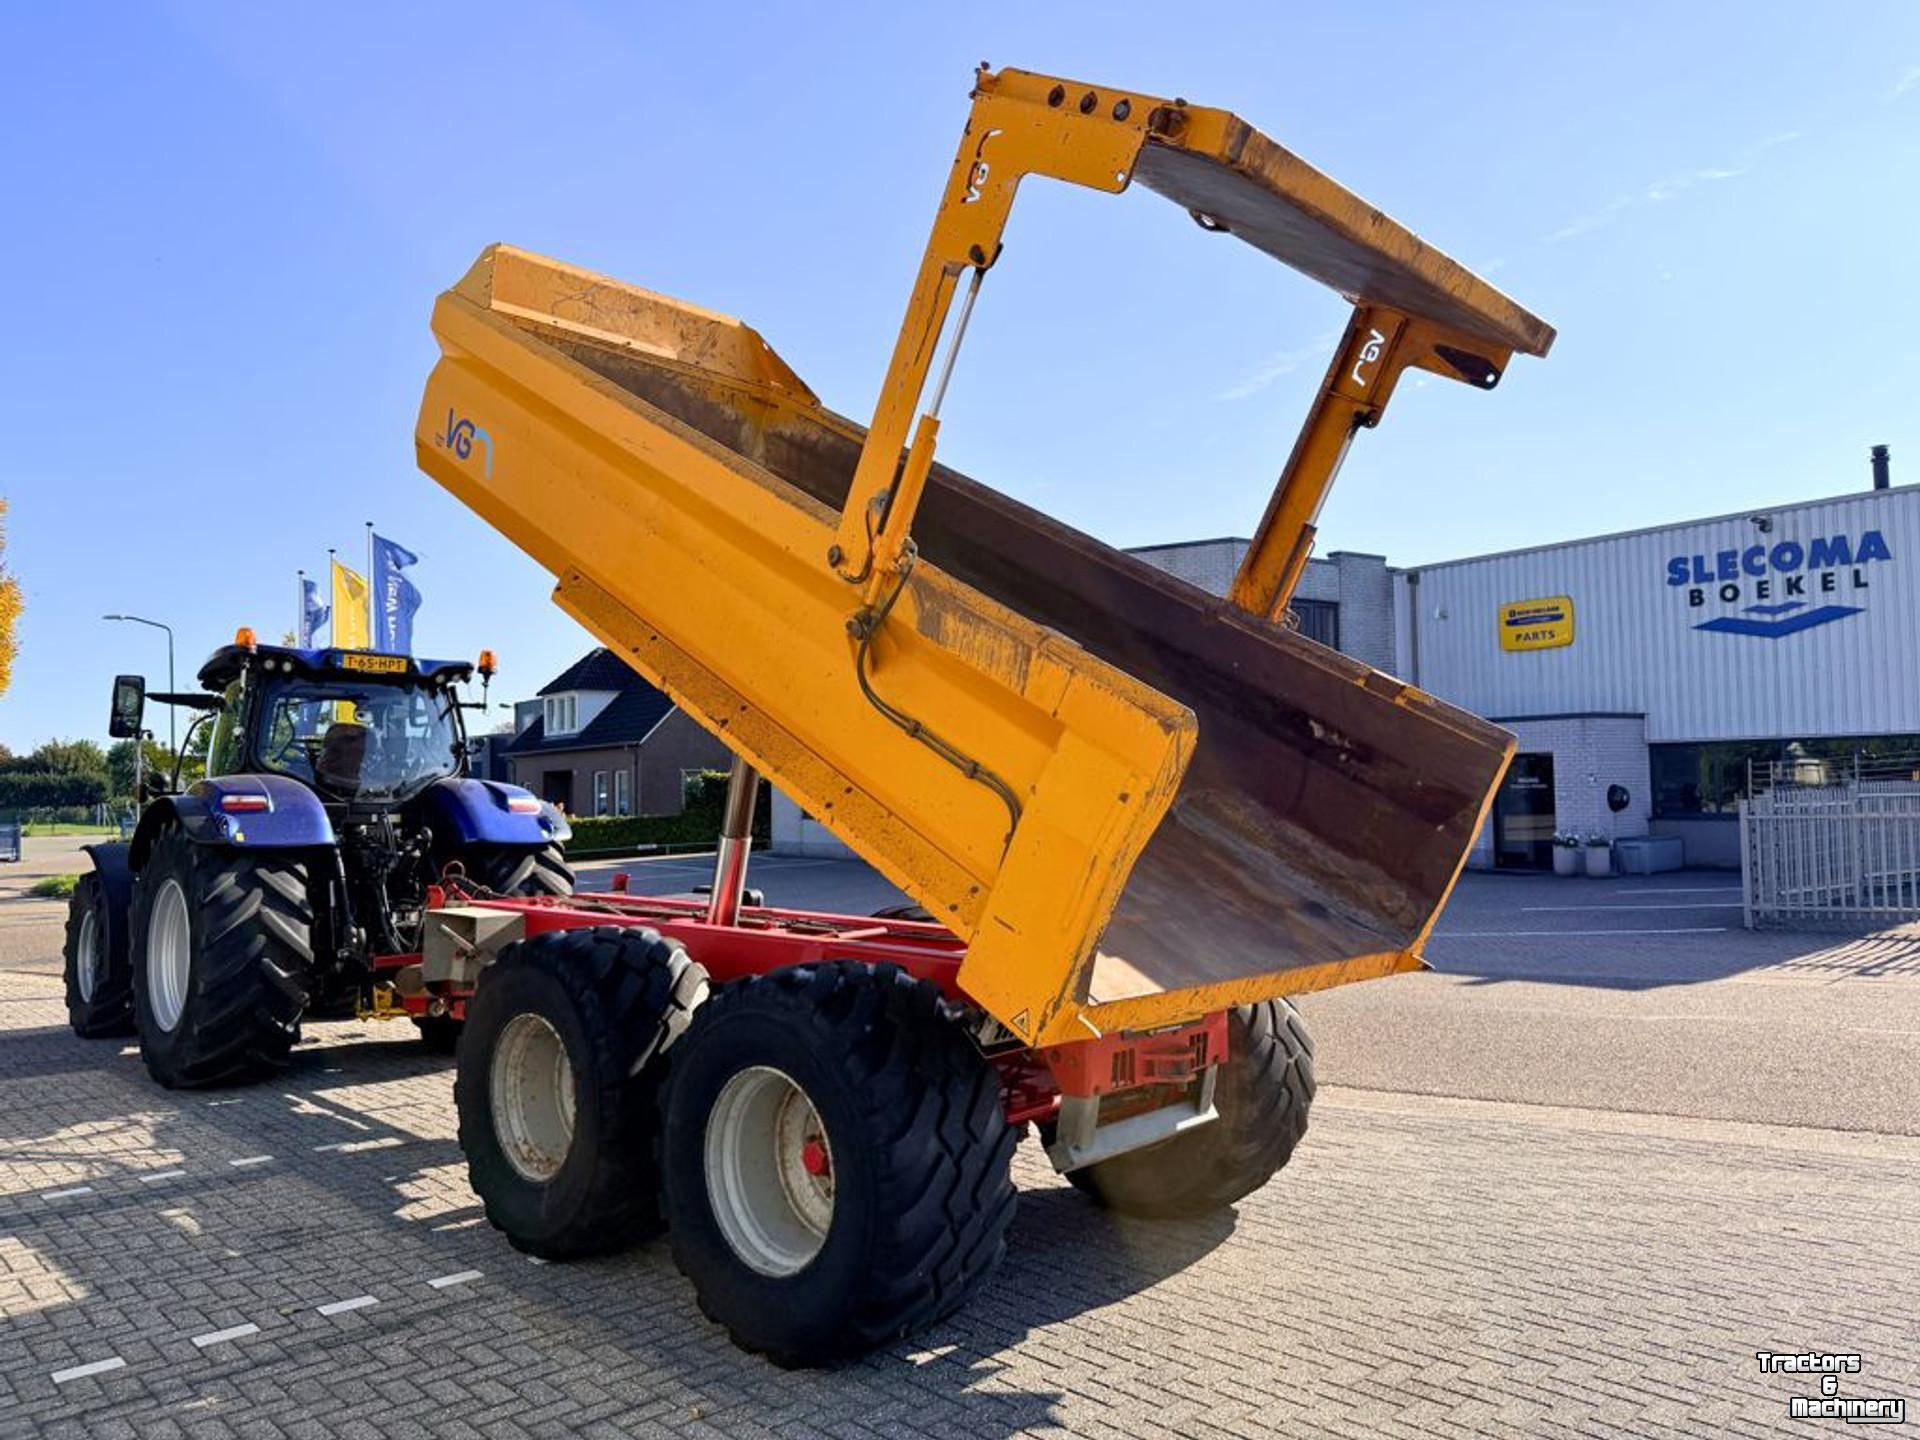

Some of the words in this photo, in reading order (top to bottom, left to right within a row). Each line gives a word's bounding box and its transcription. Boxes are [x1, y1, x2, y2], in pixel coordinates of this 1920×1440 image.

[1667, 530, 1892, 586] SLECOMA
[1689, 569, 1869, 607] BOEKEL
[1515, 630, 1556, 642] PARTS
